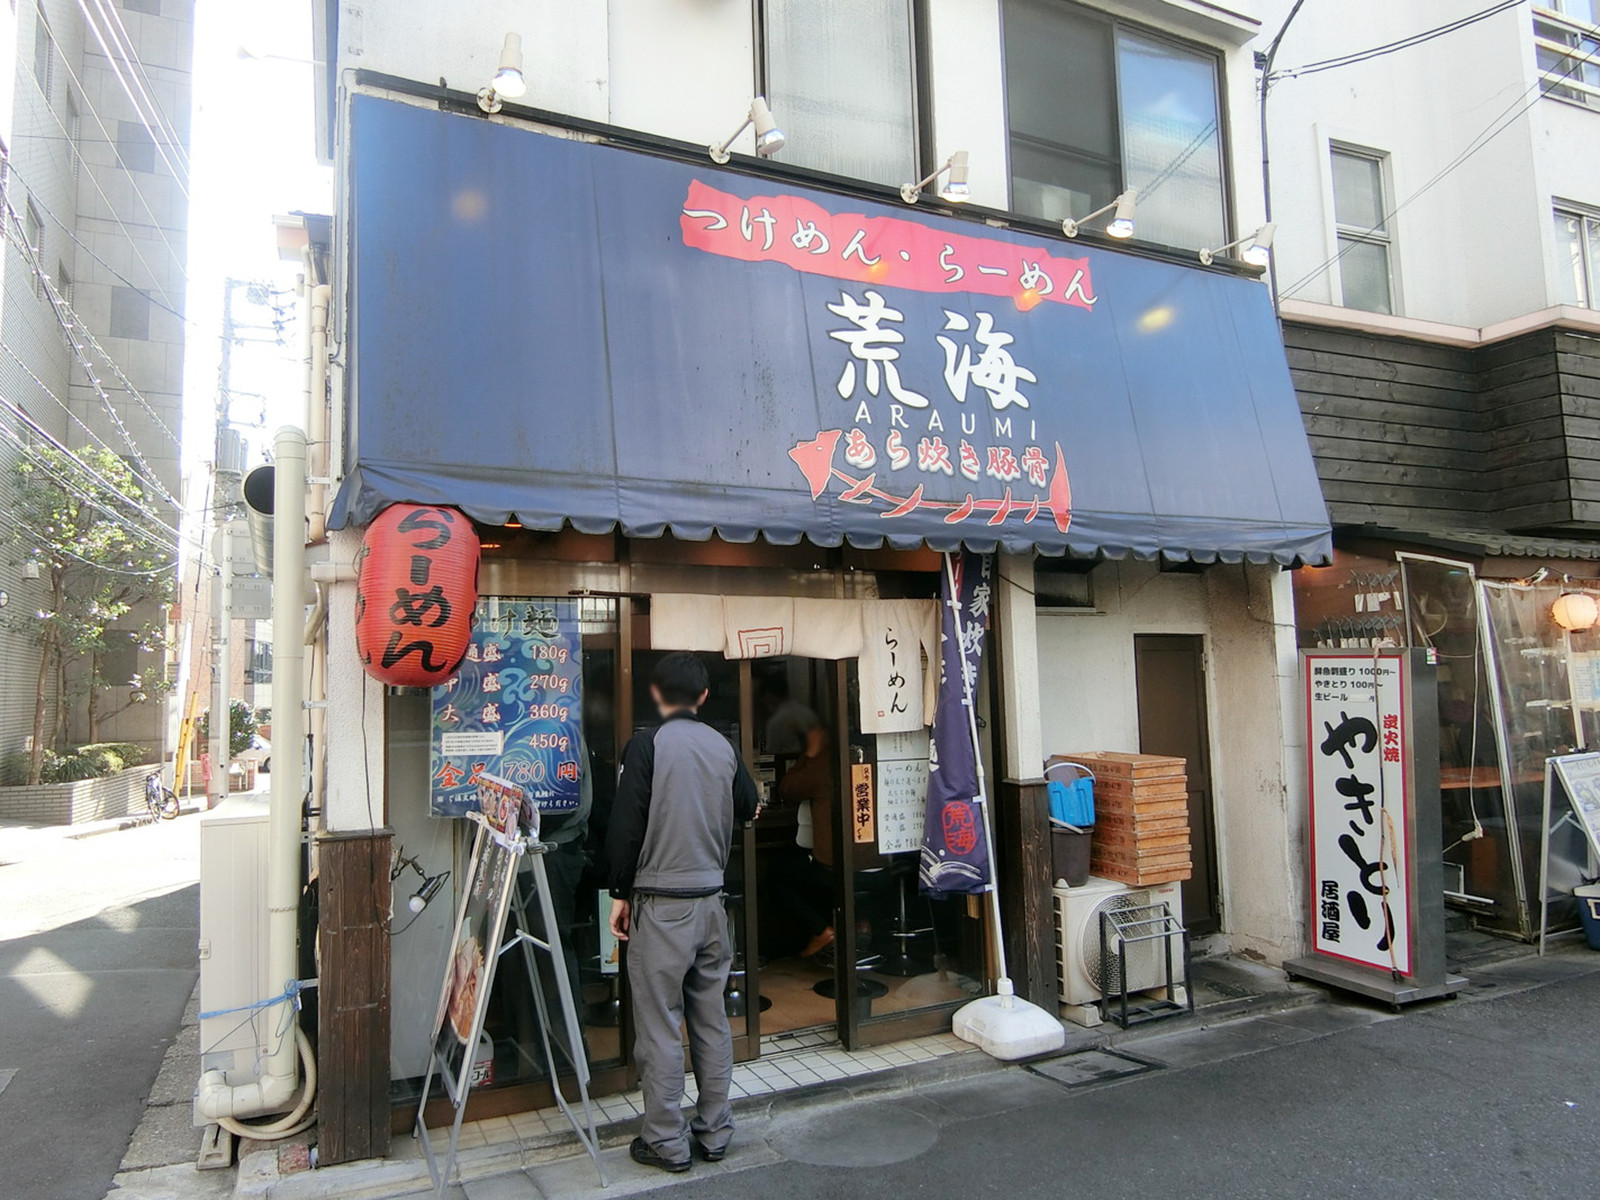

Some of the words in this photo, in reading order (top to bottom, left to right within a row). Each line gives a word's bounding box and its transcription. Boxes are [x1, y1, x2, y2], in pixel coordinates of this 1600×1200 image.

[682, 205, 1097, 305] つけめん・らーめん
[827, 290, 1037, 409] 荒海
[855, 400, 1036, 441] ARAUMI
[844, 427, 1050, 489] あら炊き豚骨
[381, 508, 454, 673] らーめん
[531, 644, 569, 664] 180g
[885, 626, 908, 714] らーめん
[530, 673, 570, 694] 270g
[1314, 680, 1347, 689] やきとり
[1314, 692, 1348, 702] 生ビール
[442, 703, 459, 724] 大
[530, 703, 569, 723] 360g
[529, 733, 569, 752] 450g
[1383, 713, 1400, 763] 炭火焼
[504, 759, 546, 783] 780
[557, 761, 578, 782] 円
[855, 782, 871, 827] 営業中
[1320, 710, 1396, 952] やきとり
[1321, 880, 1341, 943] 居酒屋
